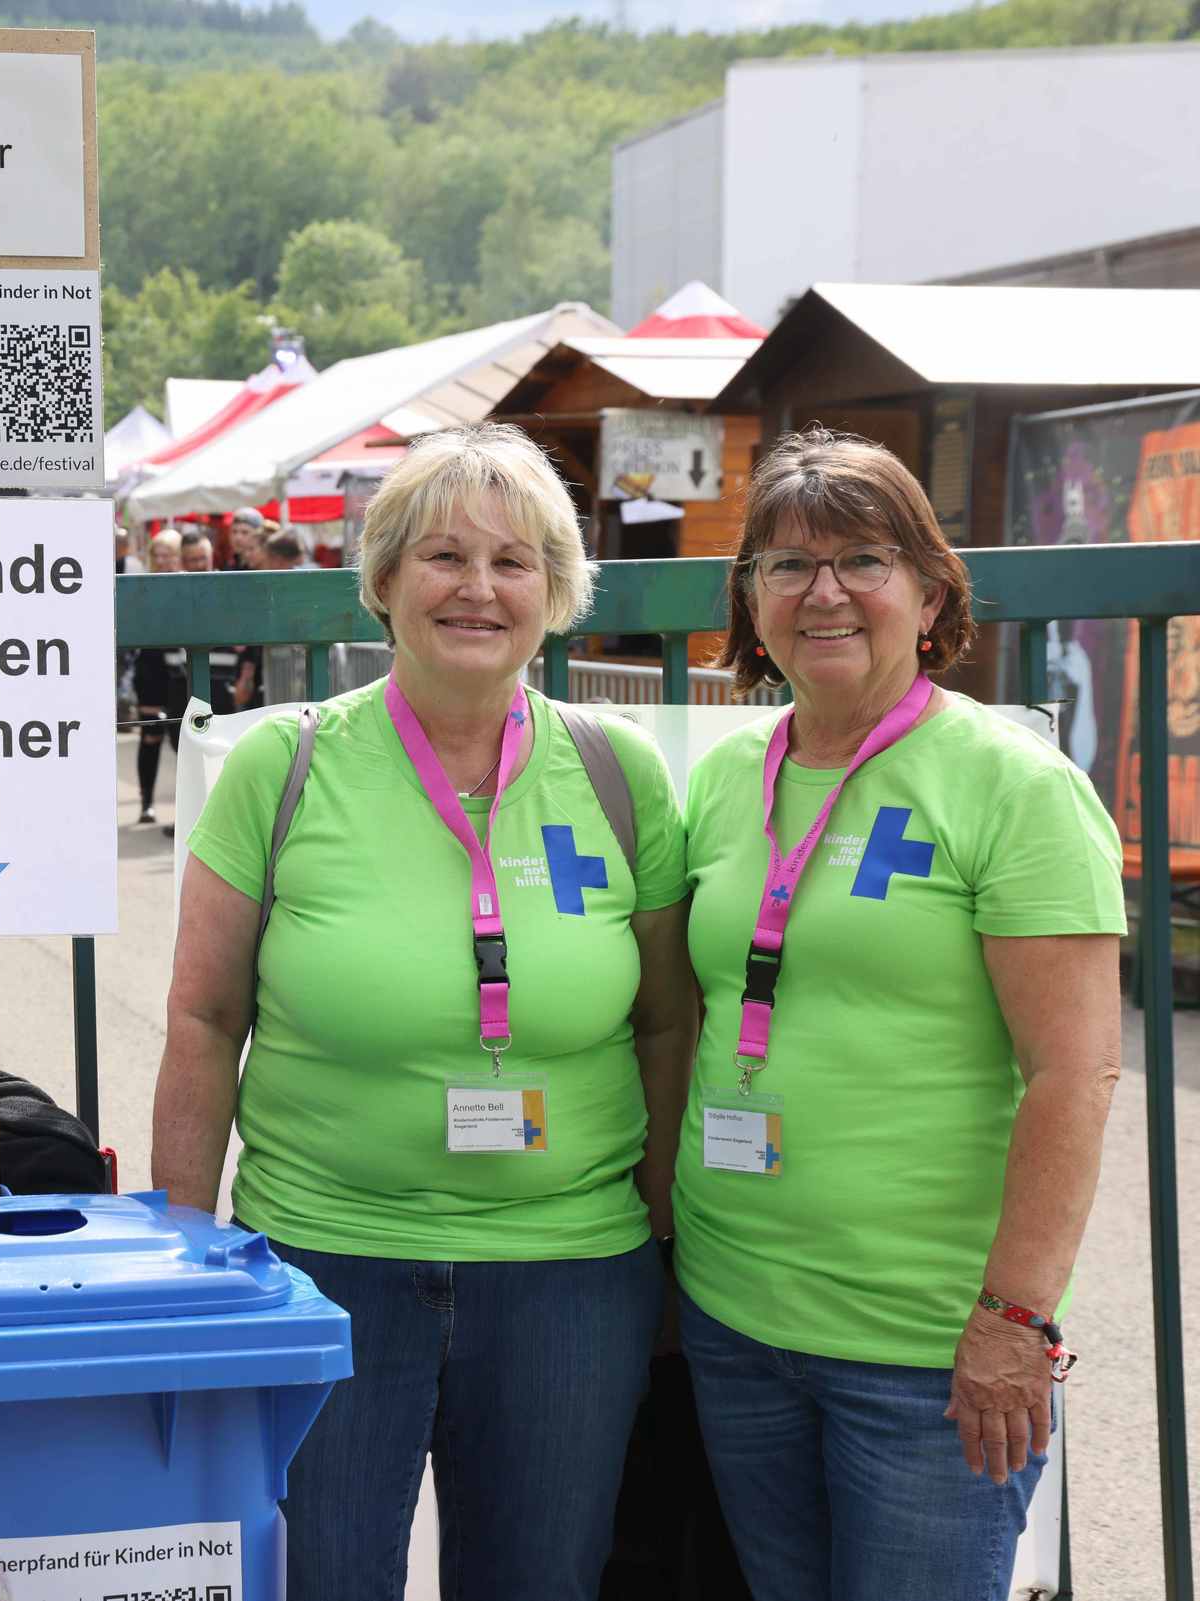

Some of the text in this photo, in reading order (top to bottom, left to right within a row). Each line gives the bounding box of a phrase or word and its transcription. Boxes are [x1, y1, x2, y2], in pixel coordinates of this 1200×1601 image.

[44, 285, 58, 299] in
[62, 285, 92, 300] Not
[823, 833, 867, 847] kinder
[840, 846, 863, 856] not
[498, 855, 545, 868] kinder
[827, 855, 859, 866] hilfe
[523, 865, 545, 876] not
[514, 876, 550, 888] hilfe
[452, 1102, 505, 1113] Annette Bell
[84, 1550, 109, 1567] für
[115, 1544, 174, 1565] Kinder
[177, 1541, 194, 1558] in
[199, 1539, 233, 1557] Not
